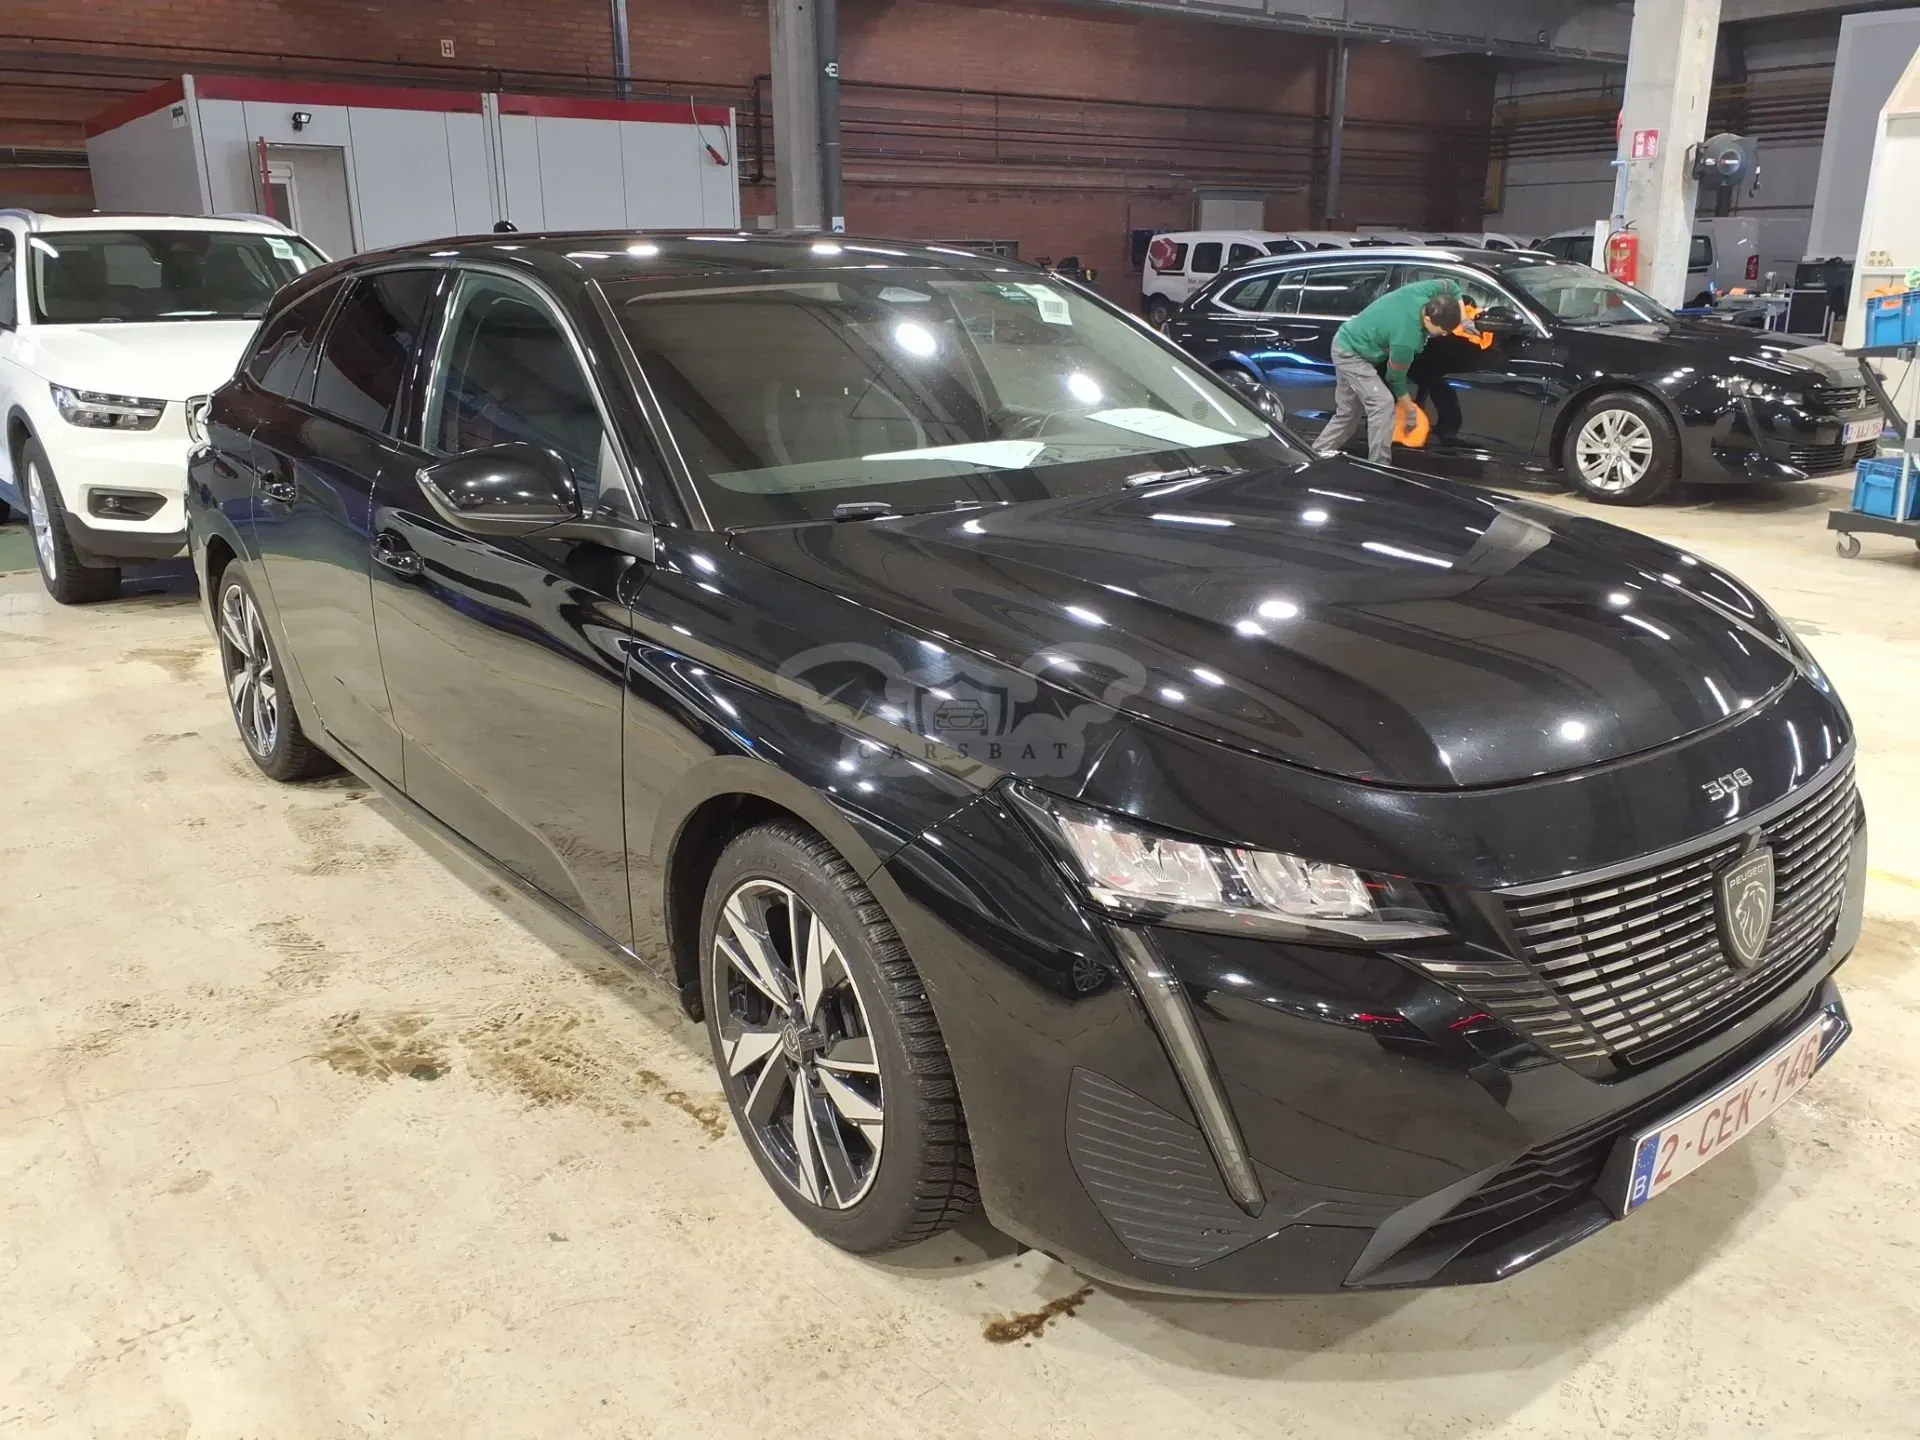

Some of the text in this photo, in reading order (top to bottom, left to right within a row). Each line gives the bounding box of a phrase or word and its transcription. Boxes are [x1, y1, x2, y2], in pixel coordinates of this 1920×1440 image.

[1701, 767, 1753, 801] 308
[1729, 863, 1767, 889] PEUGEOT
[1653, 1033, 1818, 1186] 2-CEK-746
[1631, 1175, 1647, 1200] B
